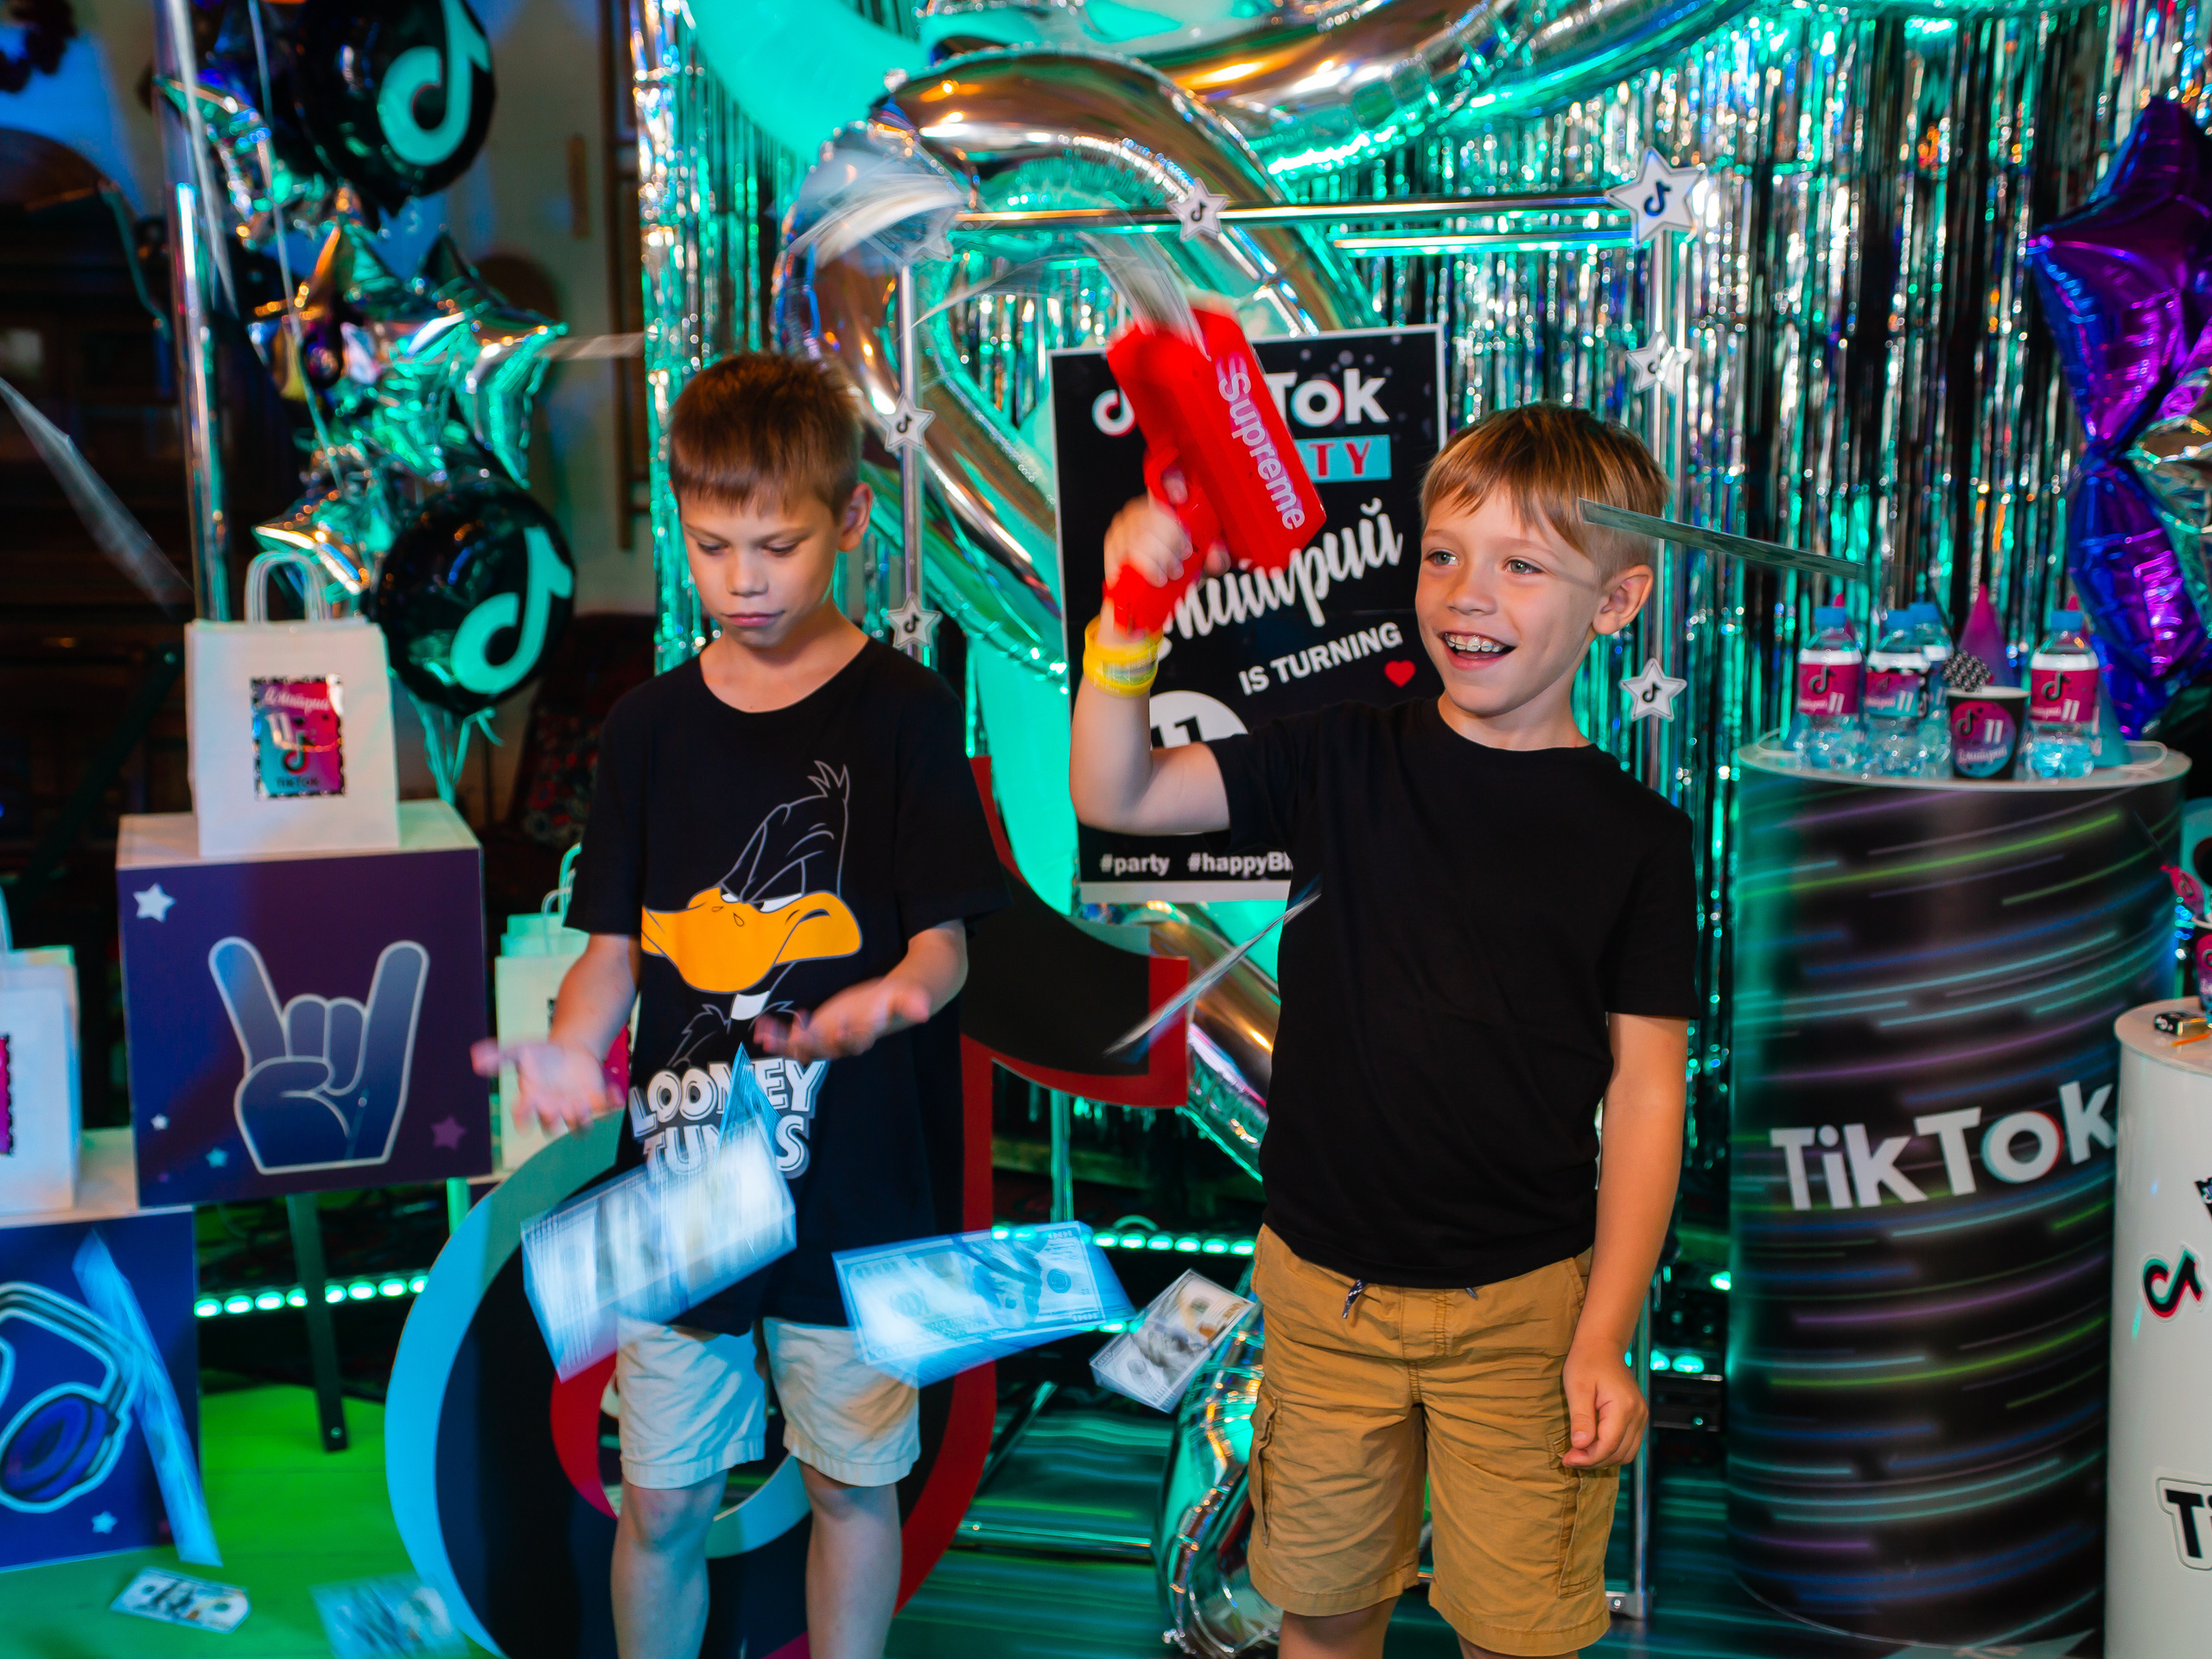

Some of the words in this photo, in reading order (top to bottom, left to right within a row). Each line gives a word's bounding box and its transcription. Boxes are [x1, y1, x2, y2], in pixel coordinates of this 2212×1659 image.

[1217, 366, 1306, 531] Supreme
[1158, 497, 1404, 661] митрий
[1238, 666, 1270, 696] IS
[1270, 621, 1404, 683] TURNING
[1099, 853, 1171, 877] #party
[1186, 850, 1294, 880] #happyBi
[1770, 1081, 2116, 1211] TikTok
